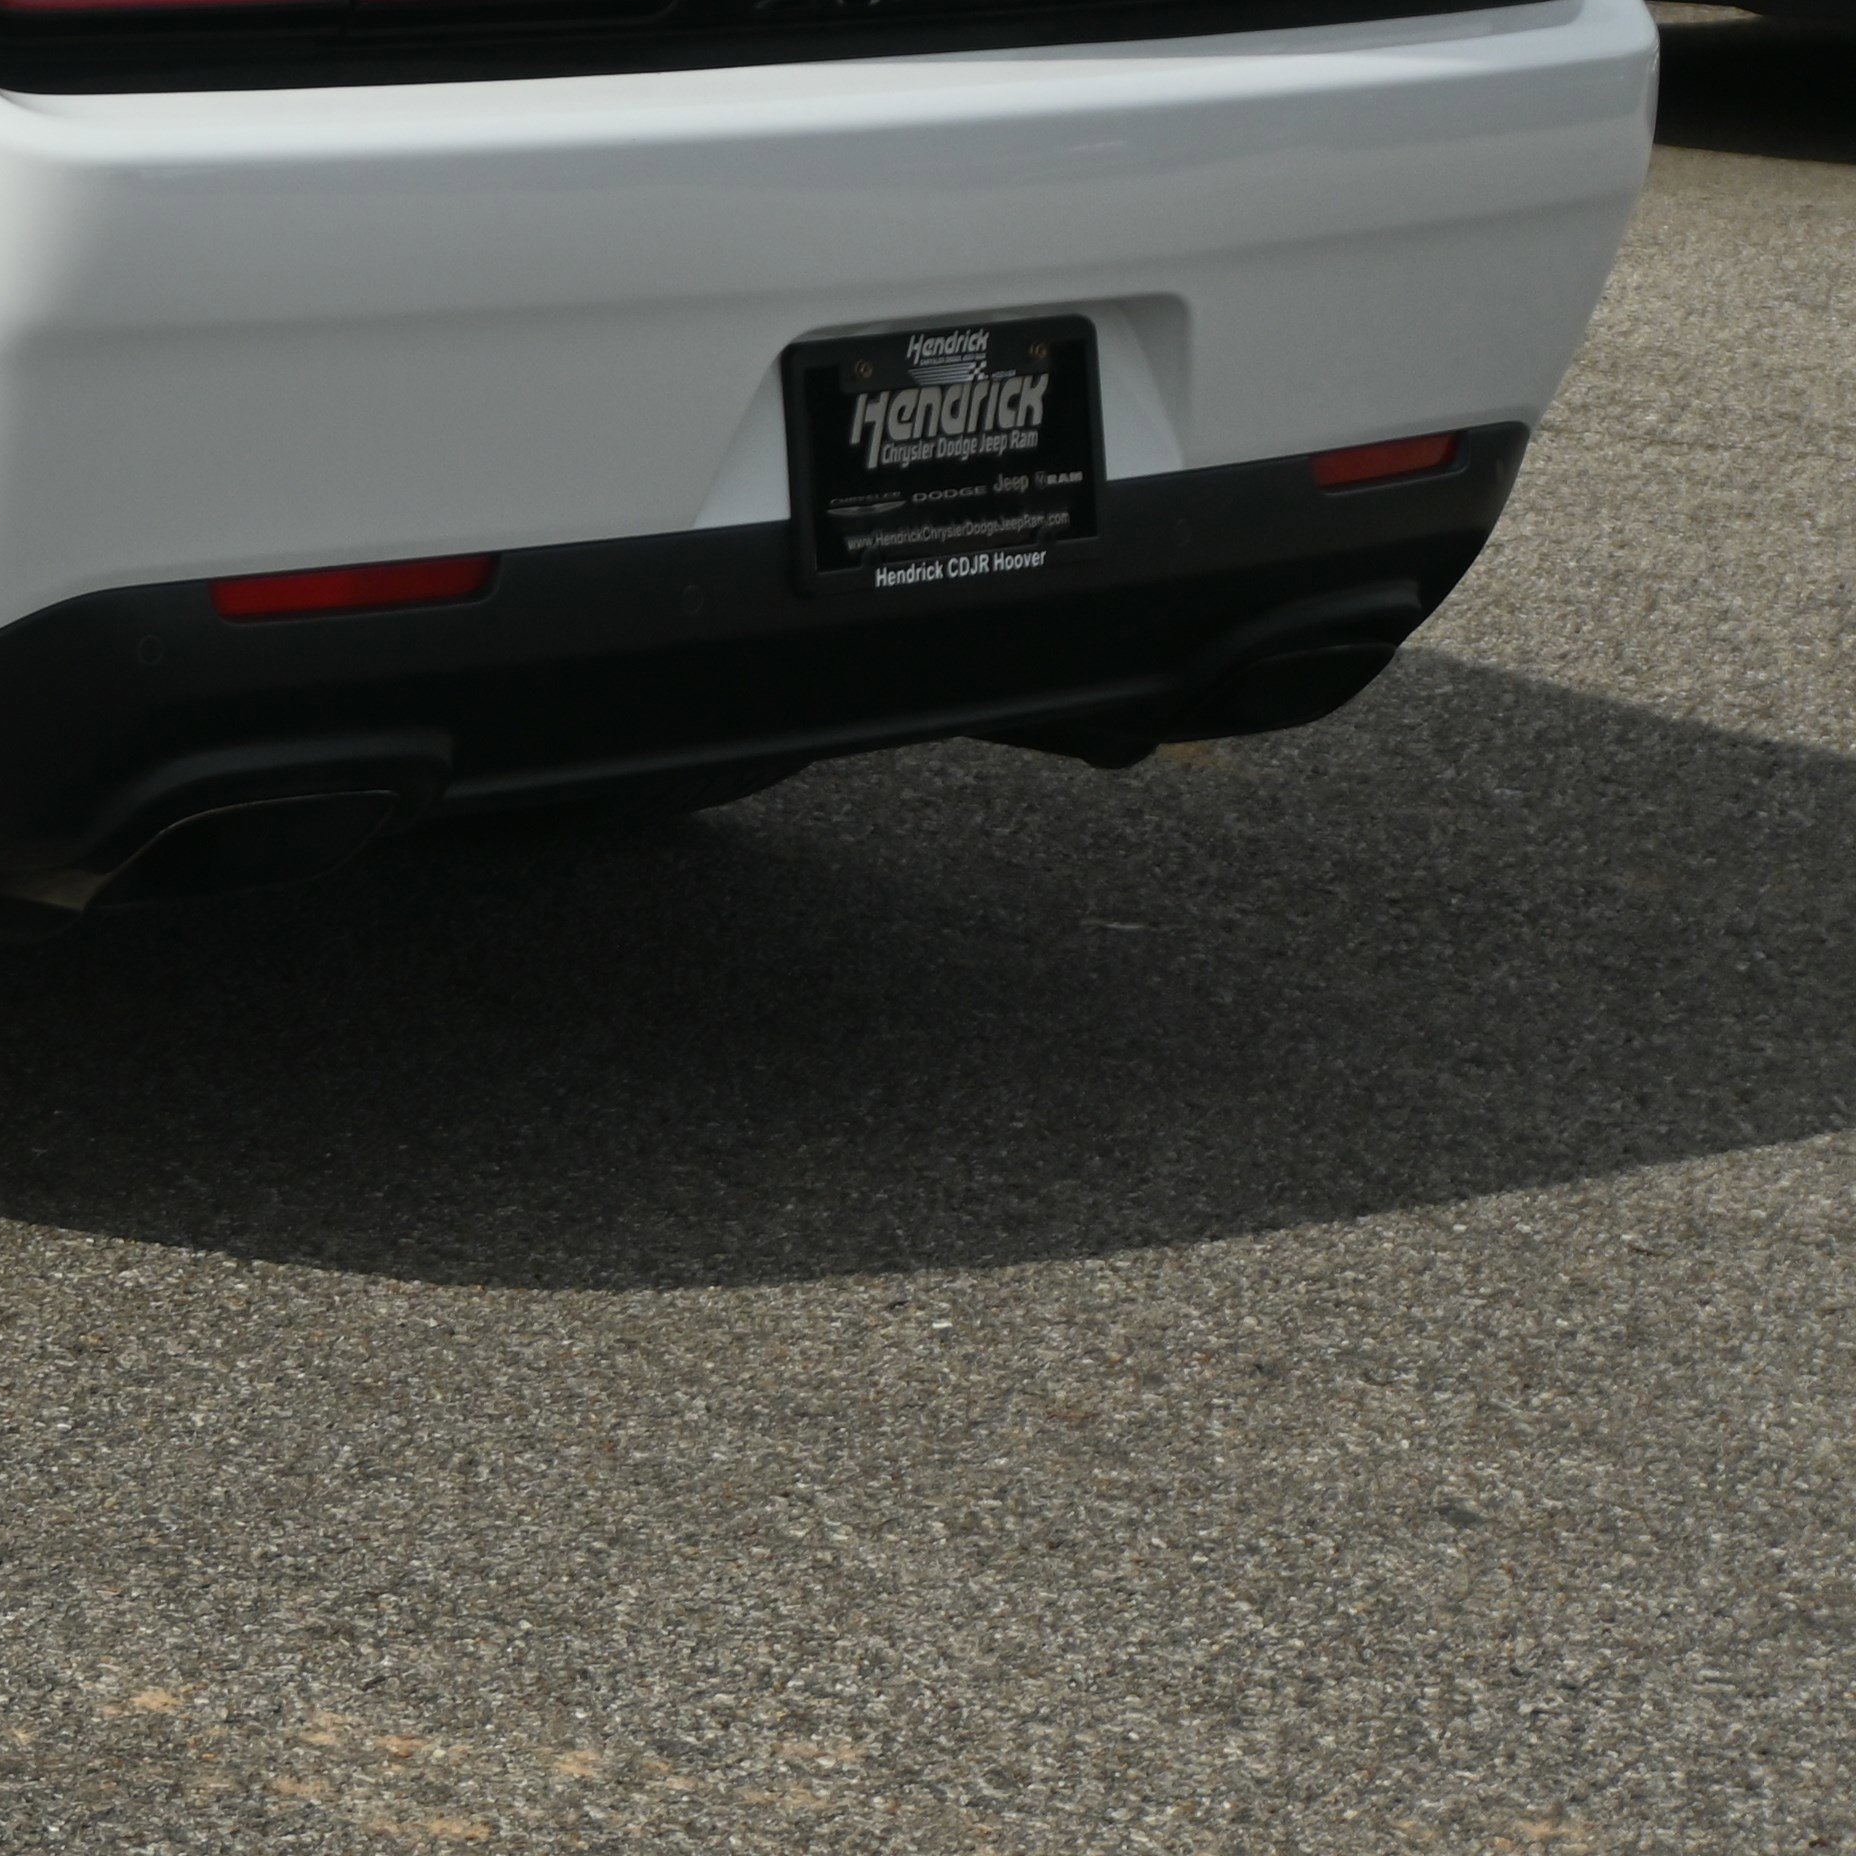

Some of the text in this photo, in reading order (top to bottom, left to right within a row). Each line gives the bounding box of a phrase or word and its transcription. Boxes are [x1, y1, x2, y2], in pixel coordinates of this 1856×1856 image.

[906, 328, 989, 366] Hendrick
[882, 429, 1039, 468] Chrysler Dodge Jeep Ram
[993, 473, 1029, 493] Jeep
[1047, 471, 1083, 486] RAM
[912, 485, 987, 503] DODGE
[875, 549, 1048, 588] Hendrick CDJR Hoover
